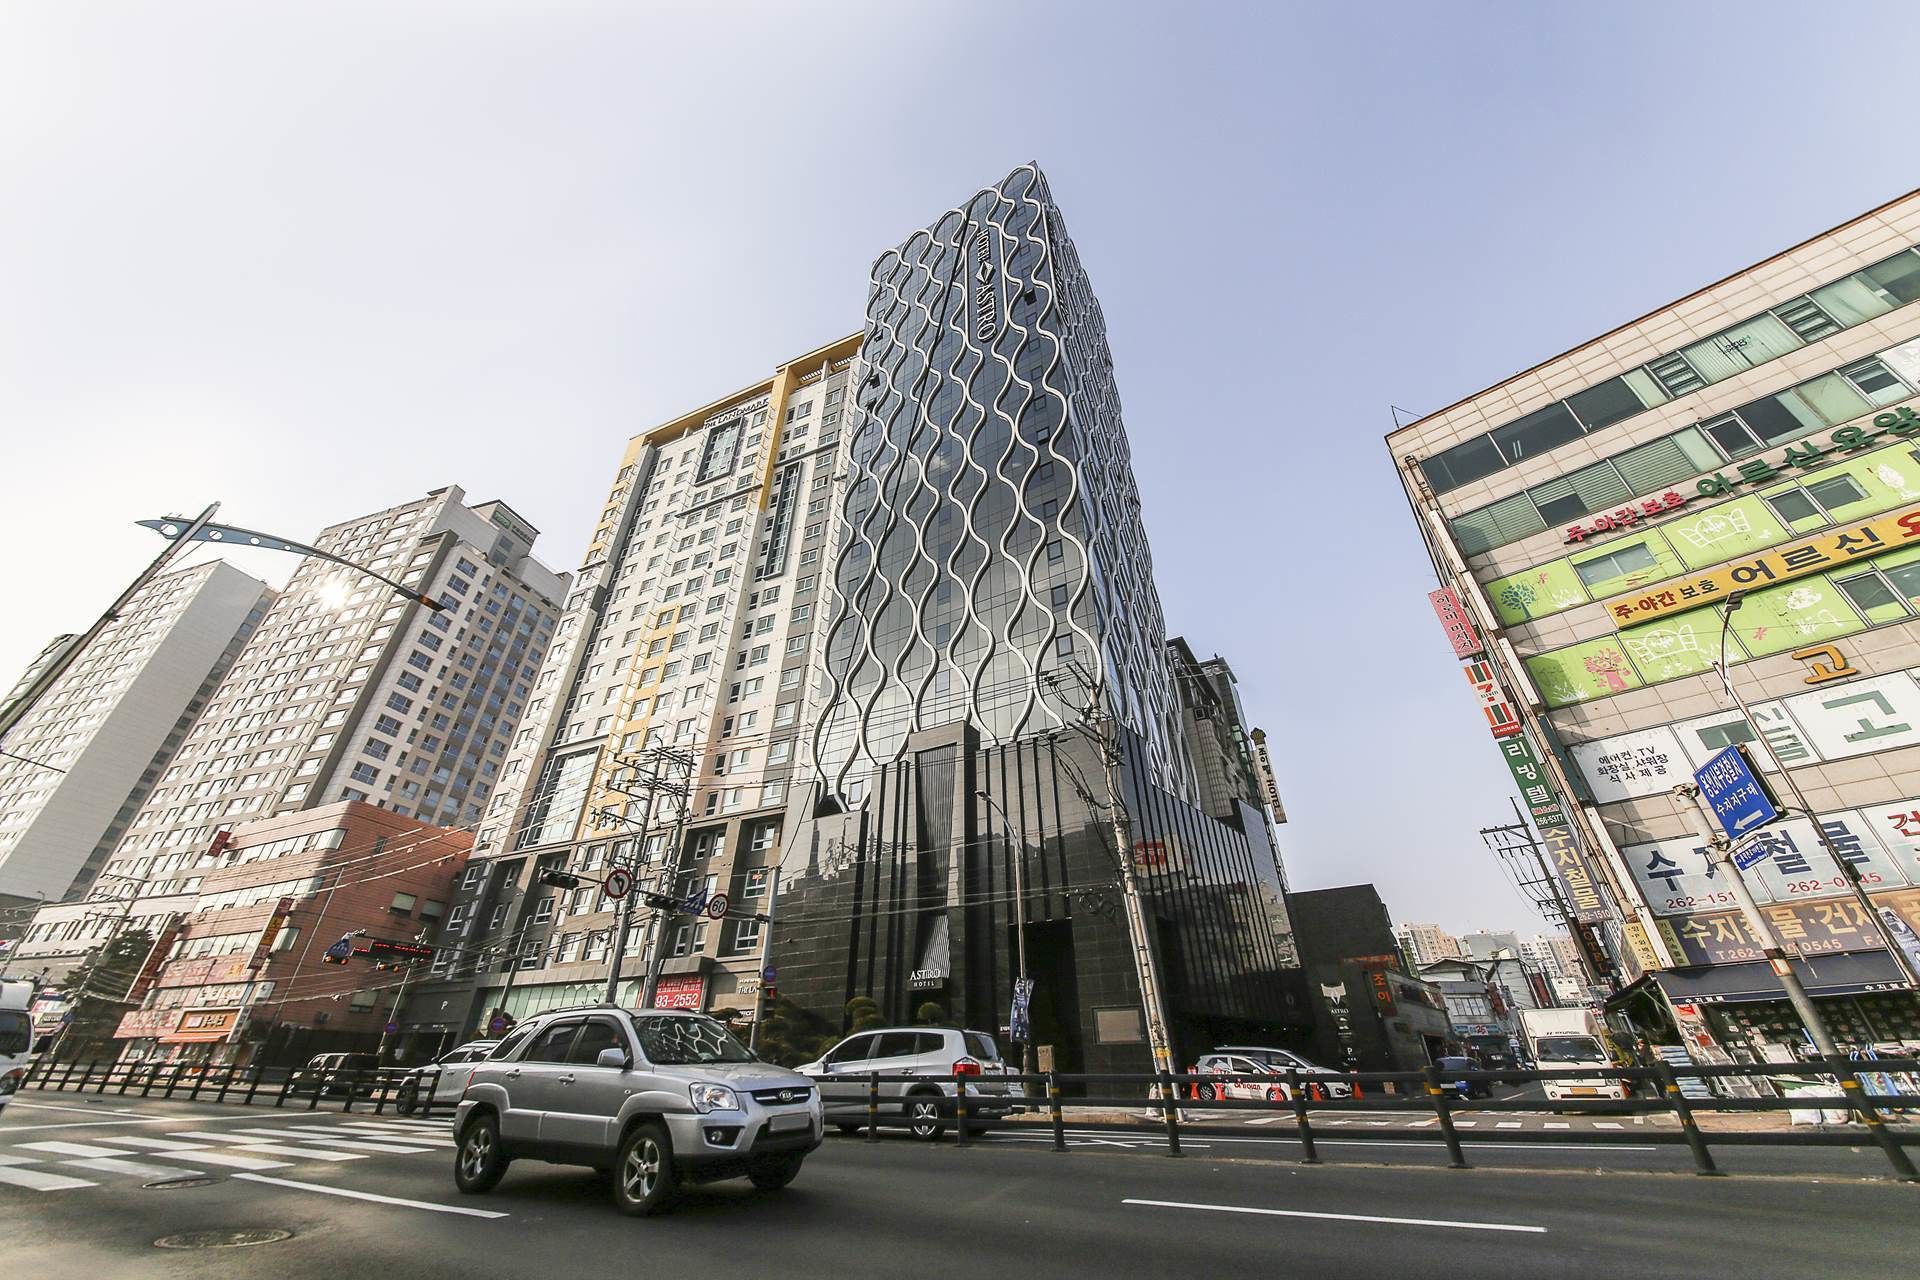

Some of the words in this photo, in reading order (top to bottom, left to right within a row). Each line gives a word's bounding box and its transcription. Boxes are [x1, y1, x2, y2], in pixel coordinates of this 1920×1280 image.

[977, 229, 990, 261] HOTEL
[976, 283, 996, 340] ASTRO
[718, 397, 769, 424] LANDMARK
[1641, 491, 1686, 517] 보호
[1679, 579, 1719, 599] 보호
[1731, 527, 1886, 584] 어르신
[1792, 645, 1858, 684] 고
[1822, 690, 1912, 743] 고
[1506, 741, 1550, 804] 리빙텔
[1716, 782, 1759, 816] 수지지구대
[1545, 827, 1601, 910] 수지철물
[1786, 872, 1883, 894] 262-045
[711, 900, 725, 913] 60
[1666, 890, 1738, 910] 262-151
[910, 968, 941, 981] ASTRO
[655, 992, 699, 1008] 93-2552
